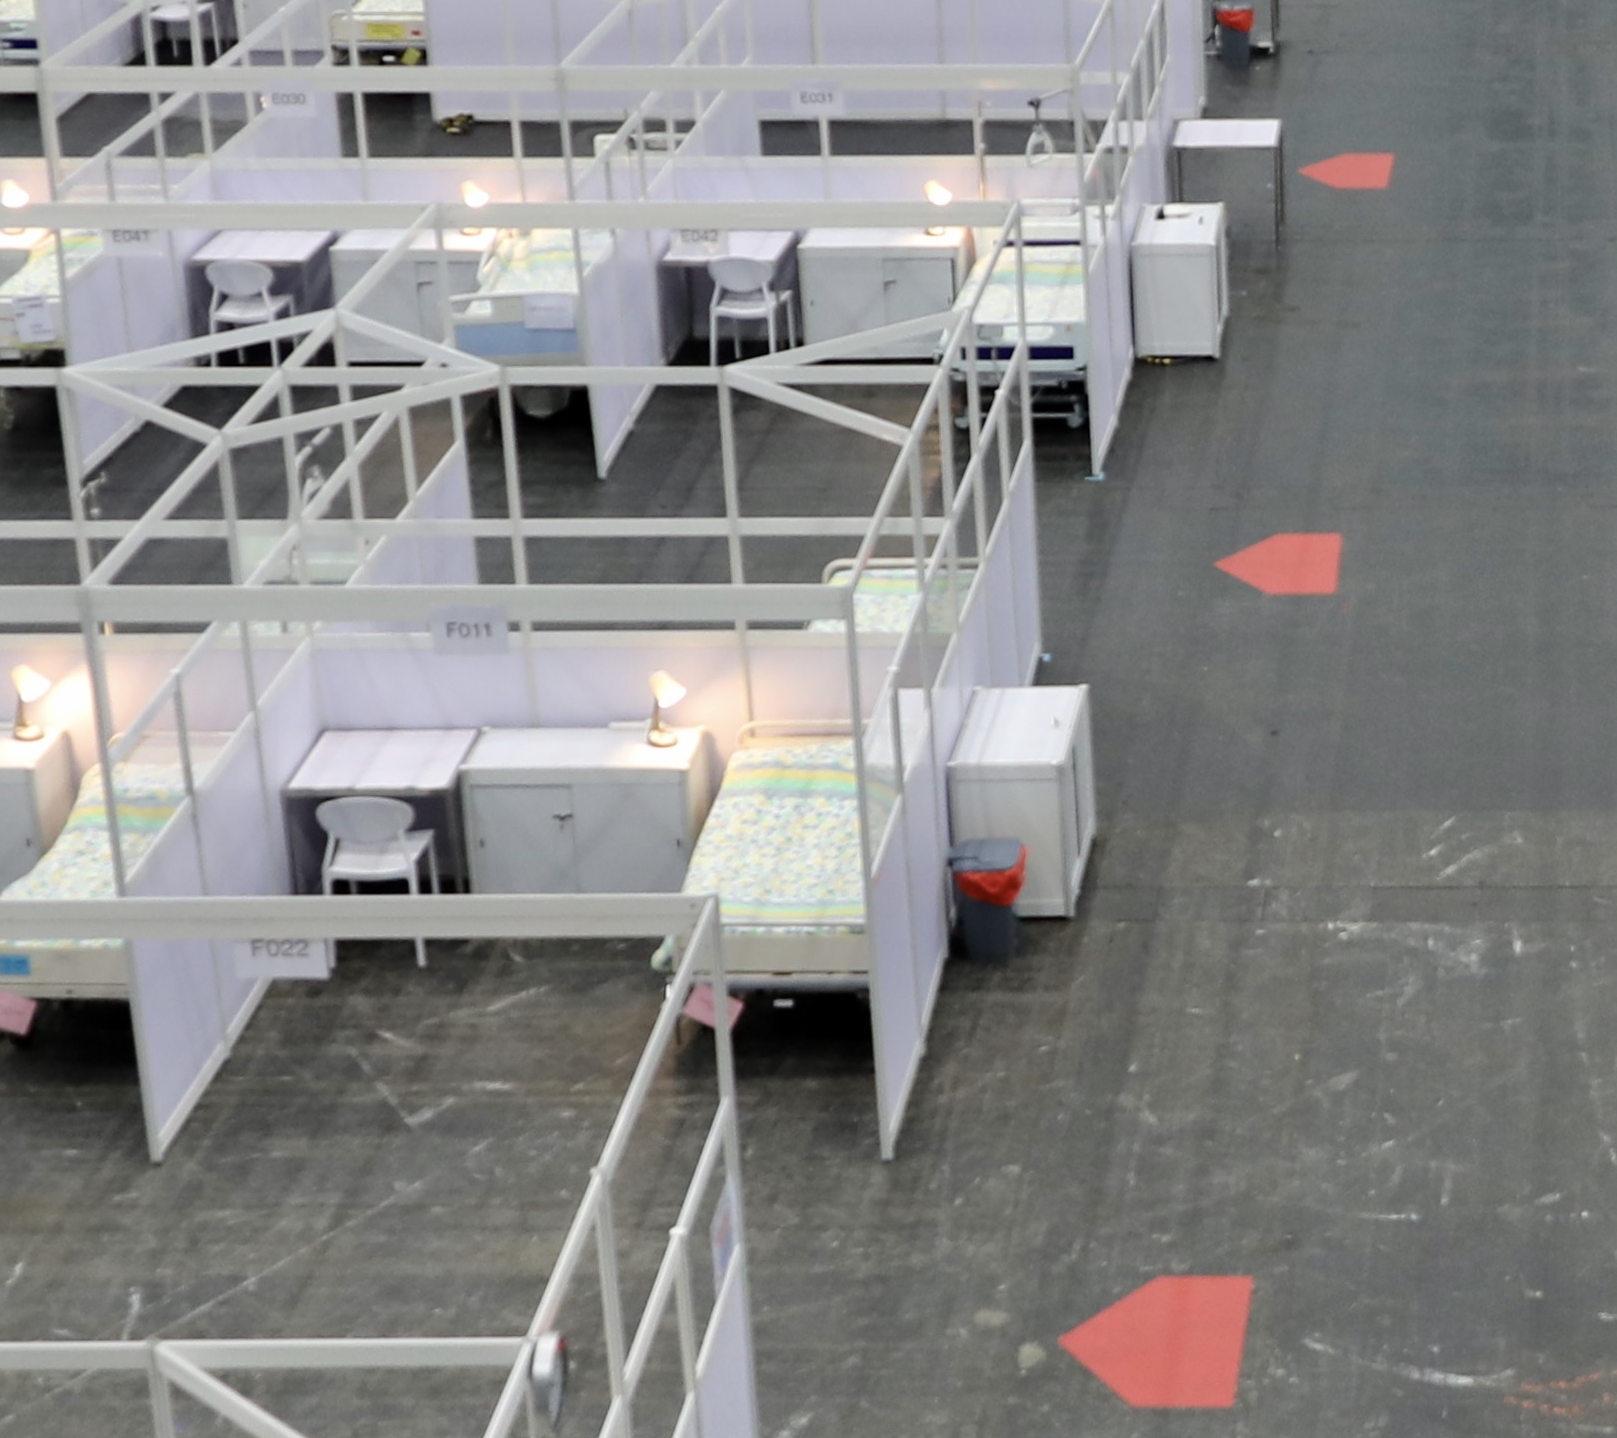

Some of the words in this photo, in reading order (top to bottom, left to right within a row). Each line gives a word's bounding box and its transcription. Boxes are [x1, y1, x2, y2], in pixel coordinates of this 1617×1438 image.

[271, 94, 306, 105] E030
[800, 92, 833, 104] E031
[113, 230, 149, 242] E041
[681, 229, 718, 242] E042
[446, 621, 493, 638] F011
[250, 938, 310, 957] F022
